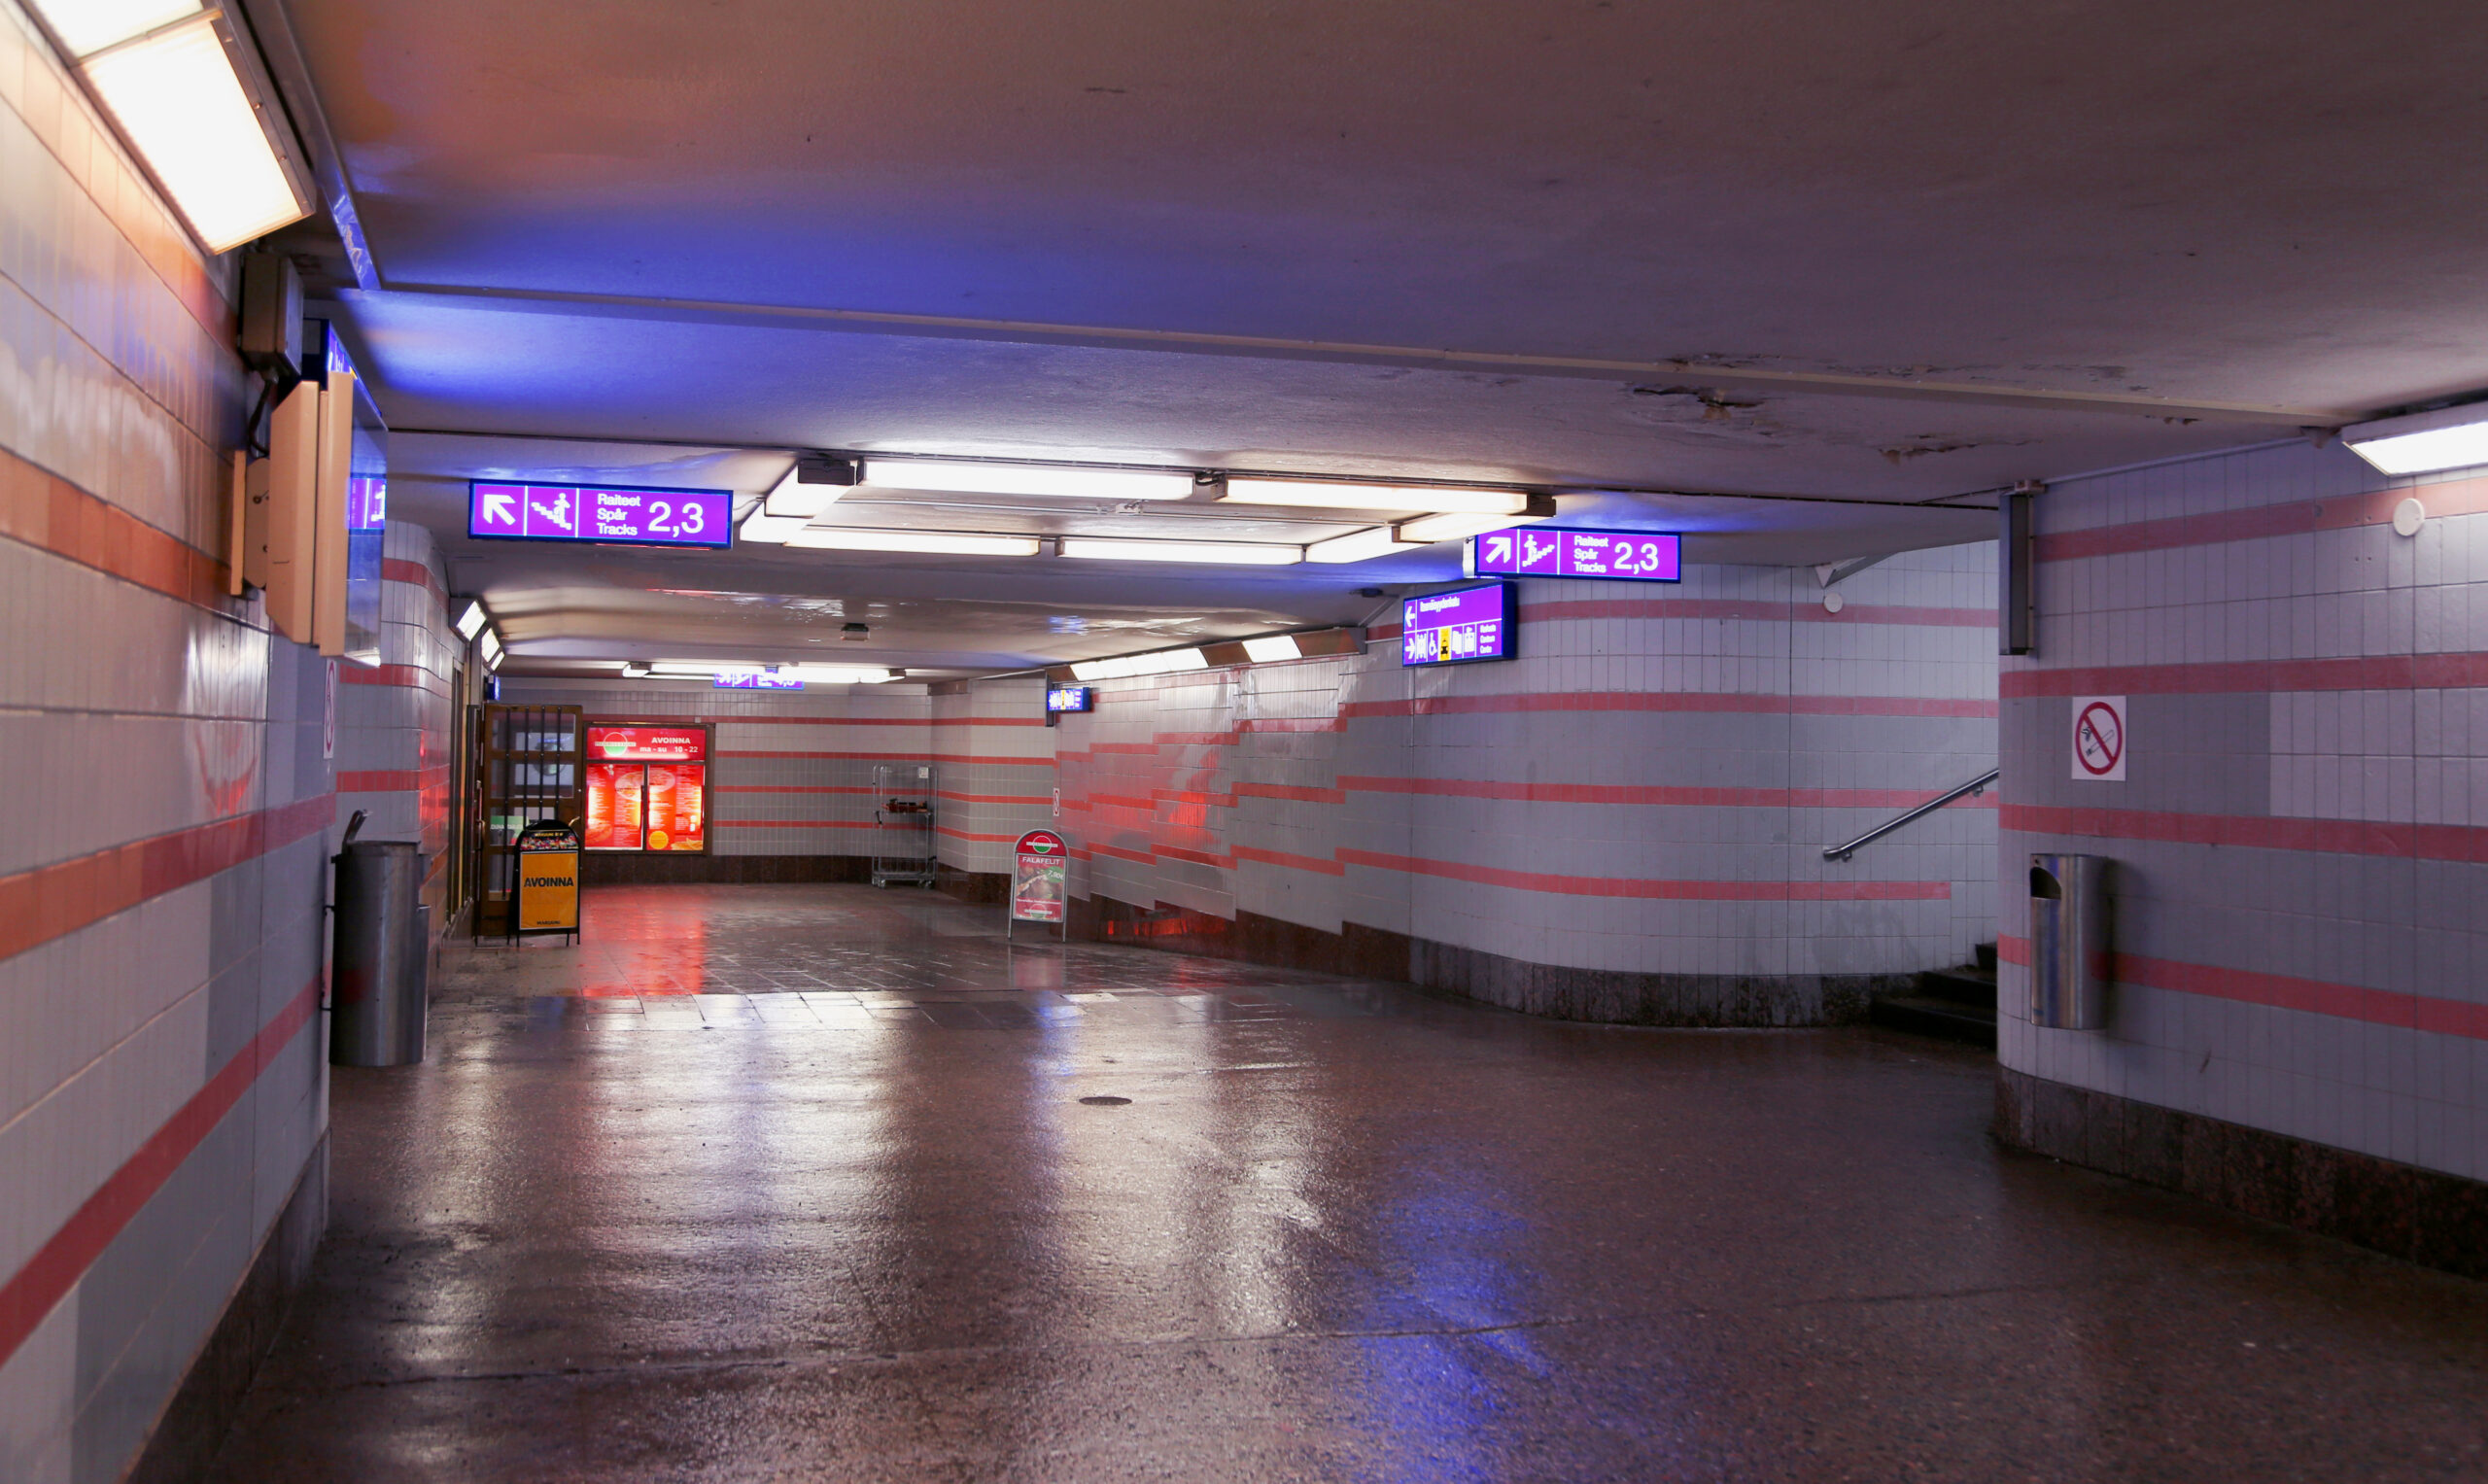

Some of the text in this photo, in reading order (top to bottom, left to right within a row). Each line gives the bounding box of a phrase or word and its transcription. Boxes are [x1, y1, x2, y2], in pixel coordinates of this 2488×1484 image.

[597, 493, 641, 507] Raiteet
[596, 507, 628, 523] Spår
[647, 500, 705, 537] 2,3
[596, 522, 638, 535] Tracks
[1613, 541, 1659, 575] 2,3
[1572, 561, 1607, 573] Tracks
[1021, 856, 1060, 865] FALAFELIT
[523, 877, 574, 887] AVOINNA
